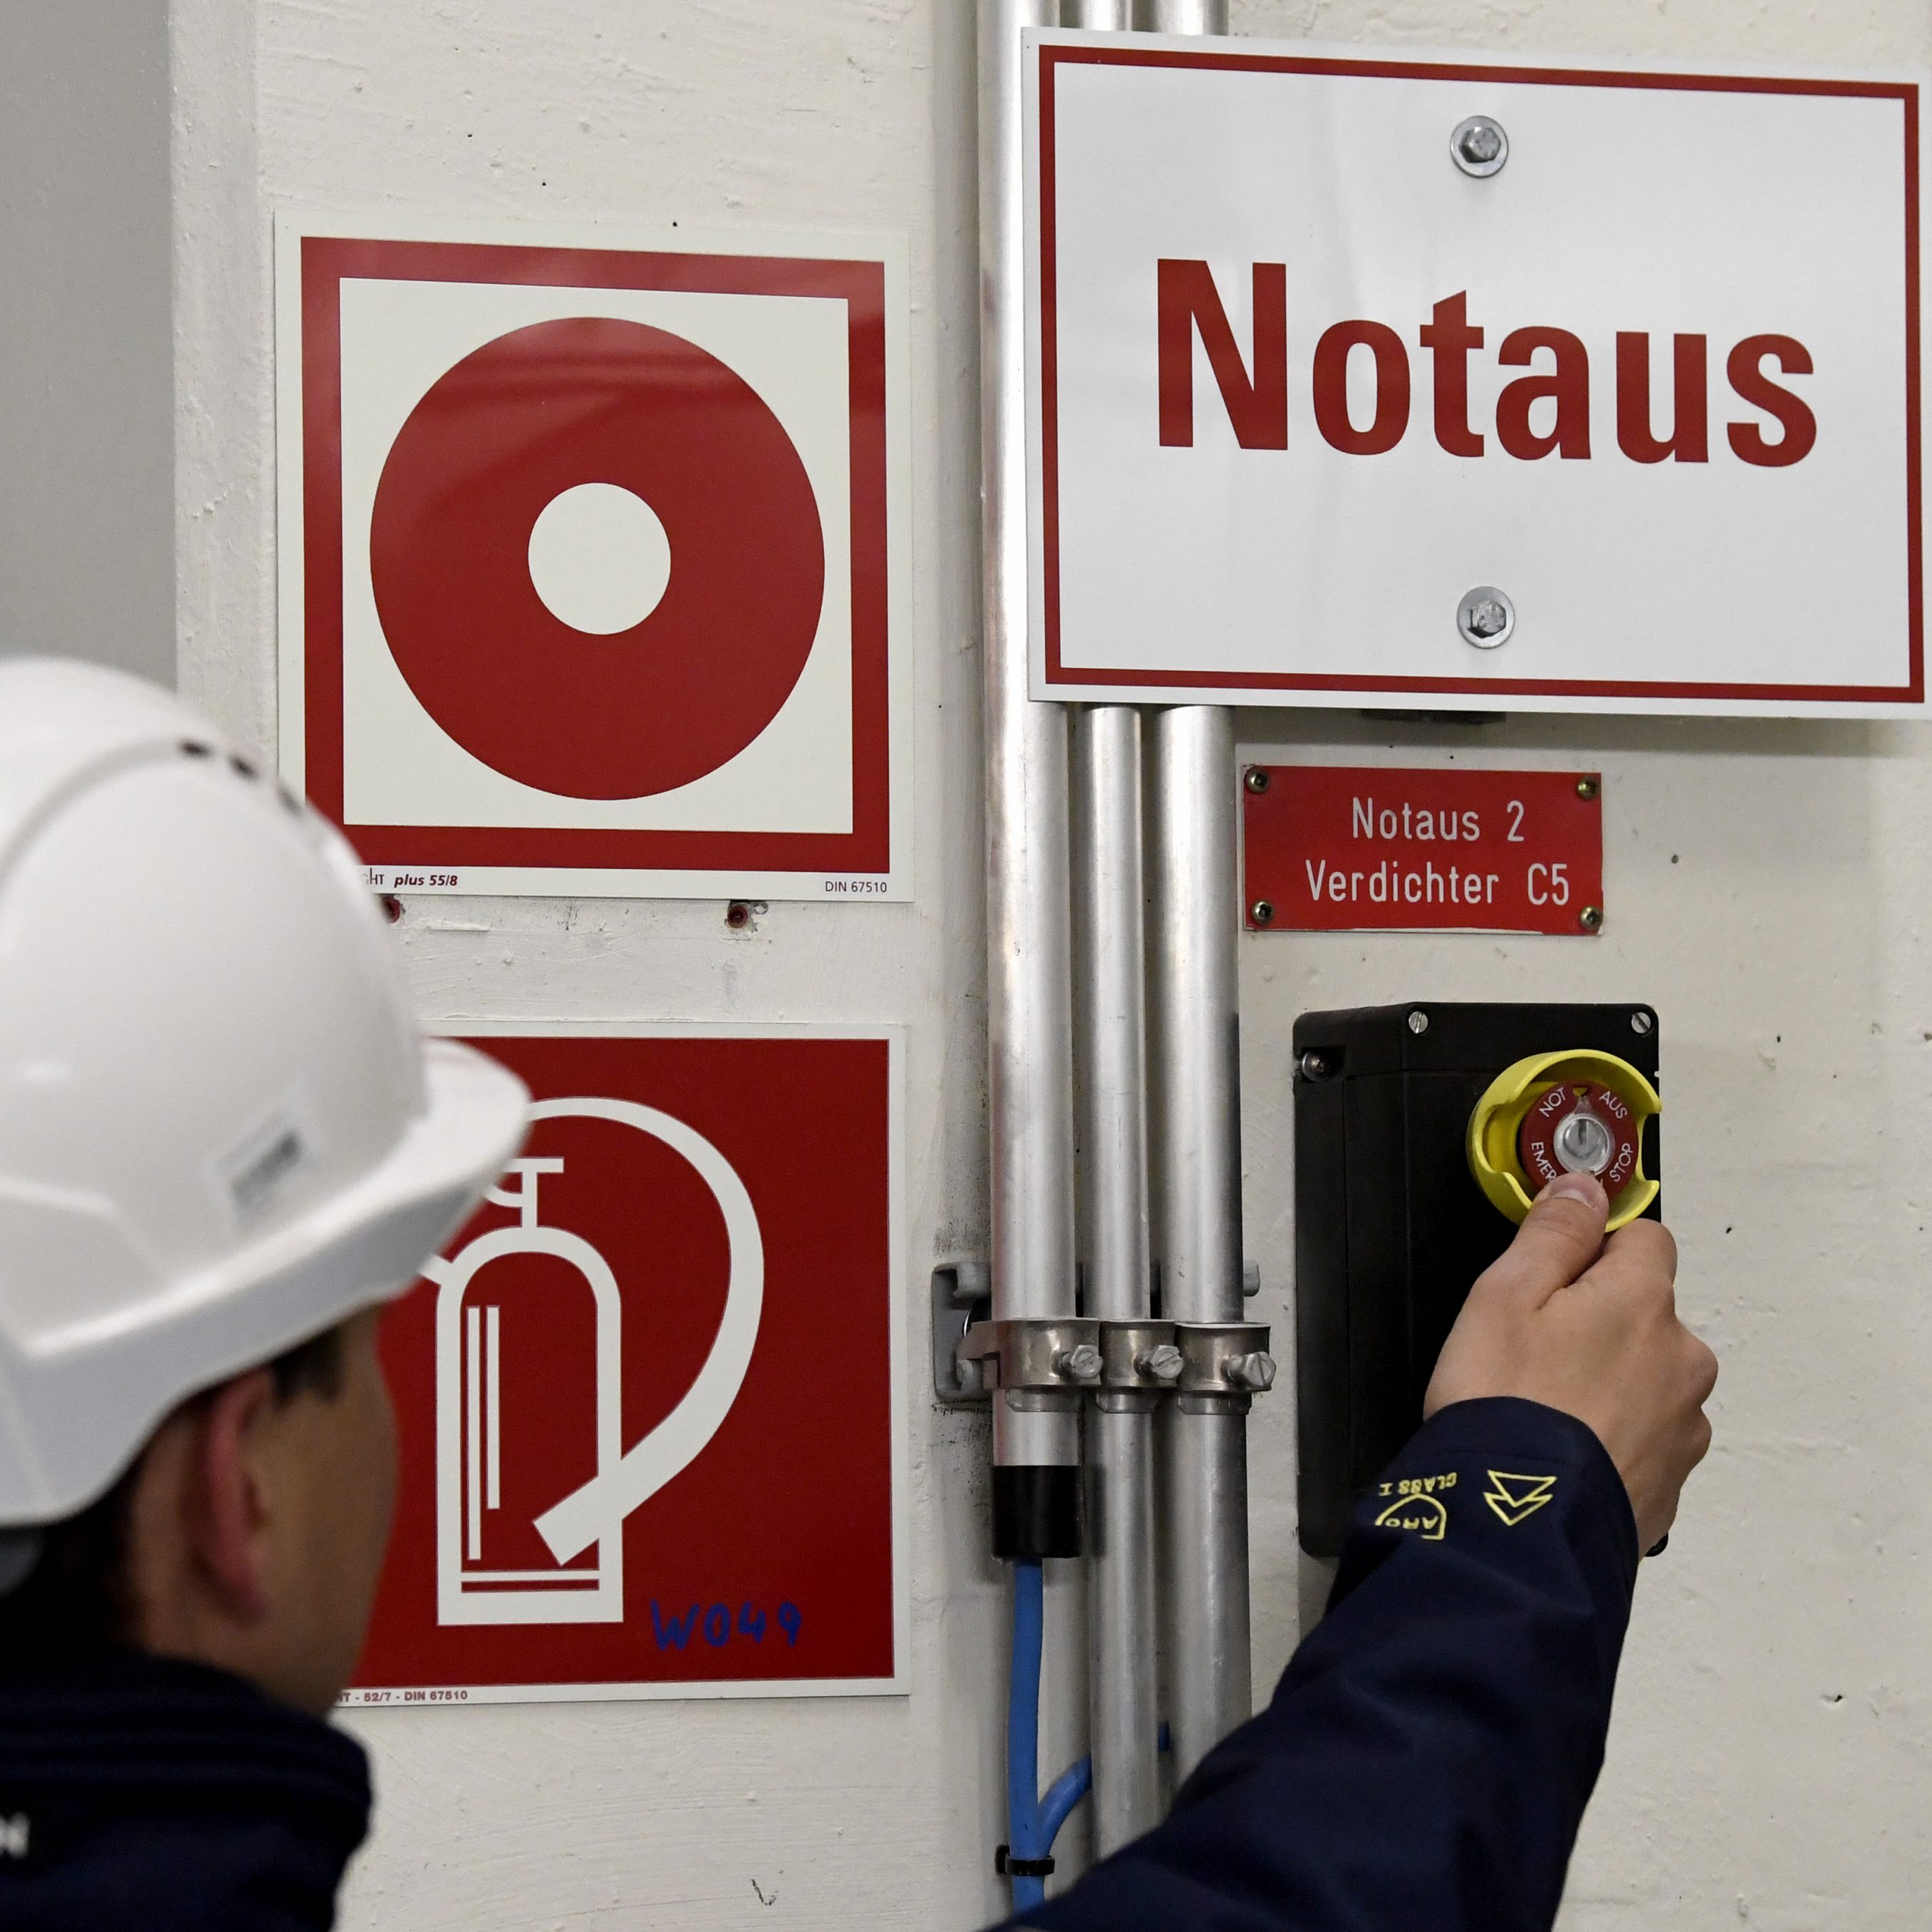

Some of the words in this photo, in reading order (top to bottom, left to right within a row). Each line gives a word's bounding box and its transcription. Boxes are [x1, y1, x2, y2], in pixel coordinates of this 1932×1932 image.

[1157, 258, 1818, 468] Notaus
[1352, 796, 1481, 841] Notaus
[1506, 800, 1525, 842] 2
[393, 873, 425, 888] plus
[428, 874, 459, 886] 55/8
[825, 881, 847, 893] DIN
[850, 881, 888, 893] 67510
[1305, 859, 1499, 903] Verdichter
[1527, 863, 1570, 906] C5
[1538, 1087, 1566, 1118] NOT
[1598, 1090, 1628, 1119] AUS
[1609, 1142, 1634, 1183] STOP
[363, 1692, 392, 1702] 52/7
[403, 1690, 426, 1701] DIN
[429, 1690, 469, 1701] 67510
